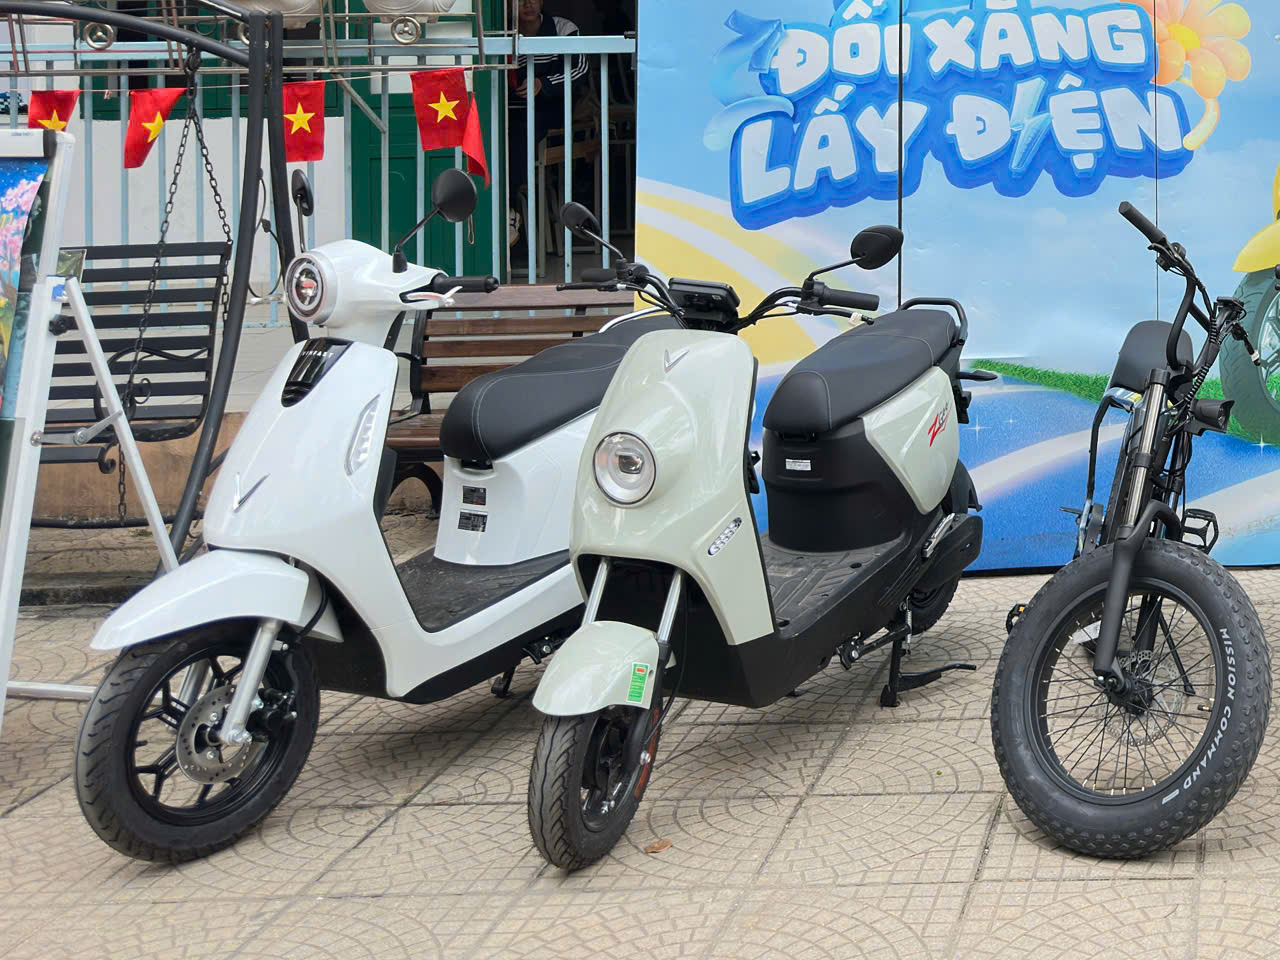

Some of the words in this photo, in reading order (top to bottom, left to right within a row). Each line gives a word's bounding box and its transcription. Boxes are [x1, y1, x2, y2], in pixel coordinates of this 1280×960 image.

[741, 83, 928, 204] LẤY
[1219, 628, 1236, 701] MISSION
[1183, 705, 1231, 790] COMMAND
